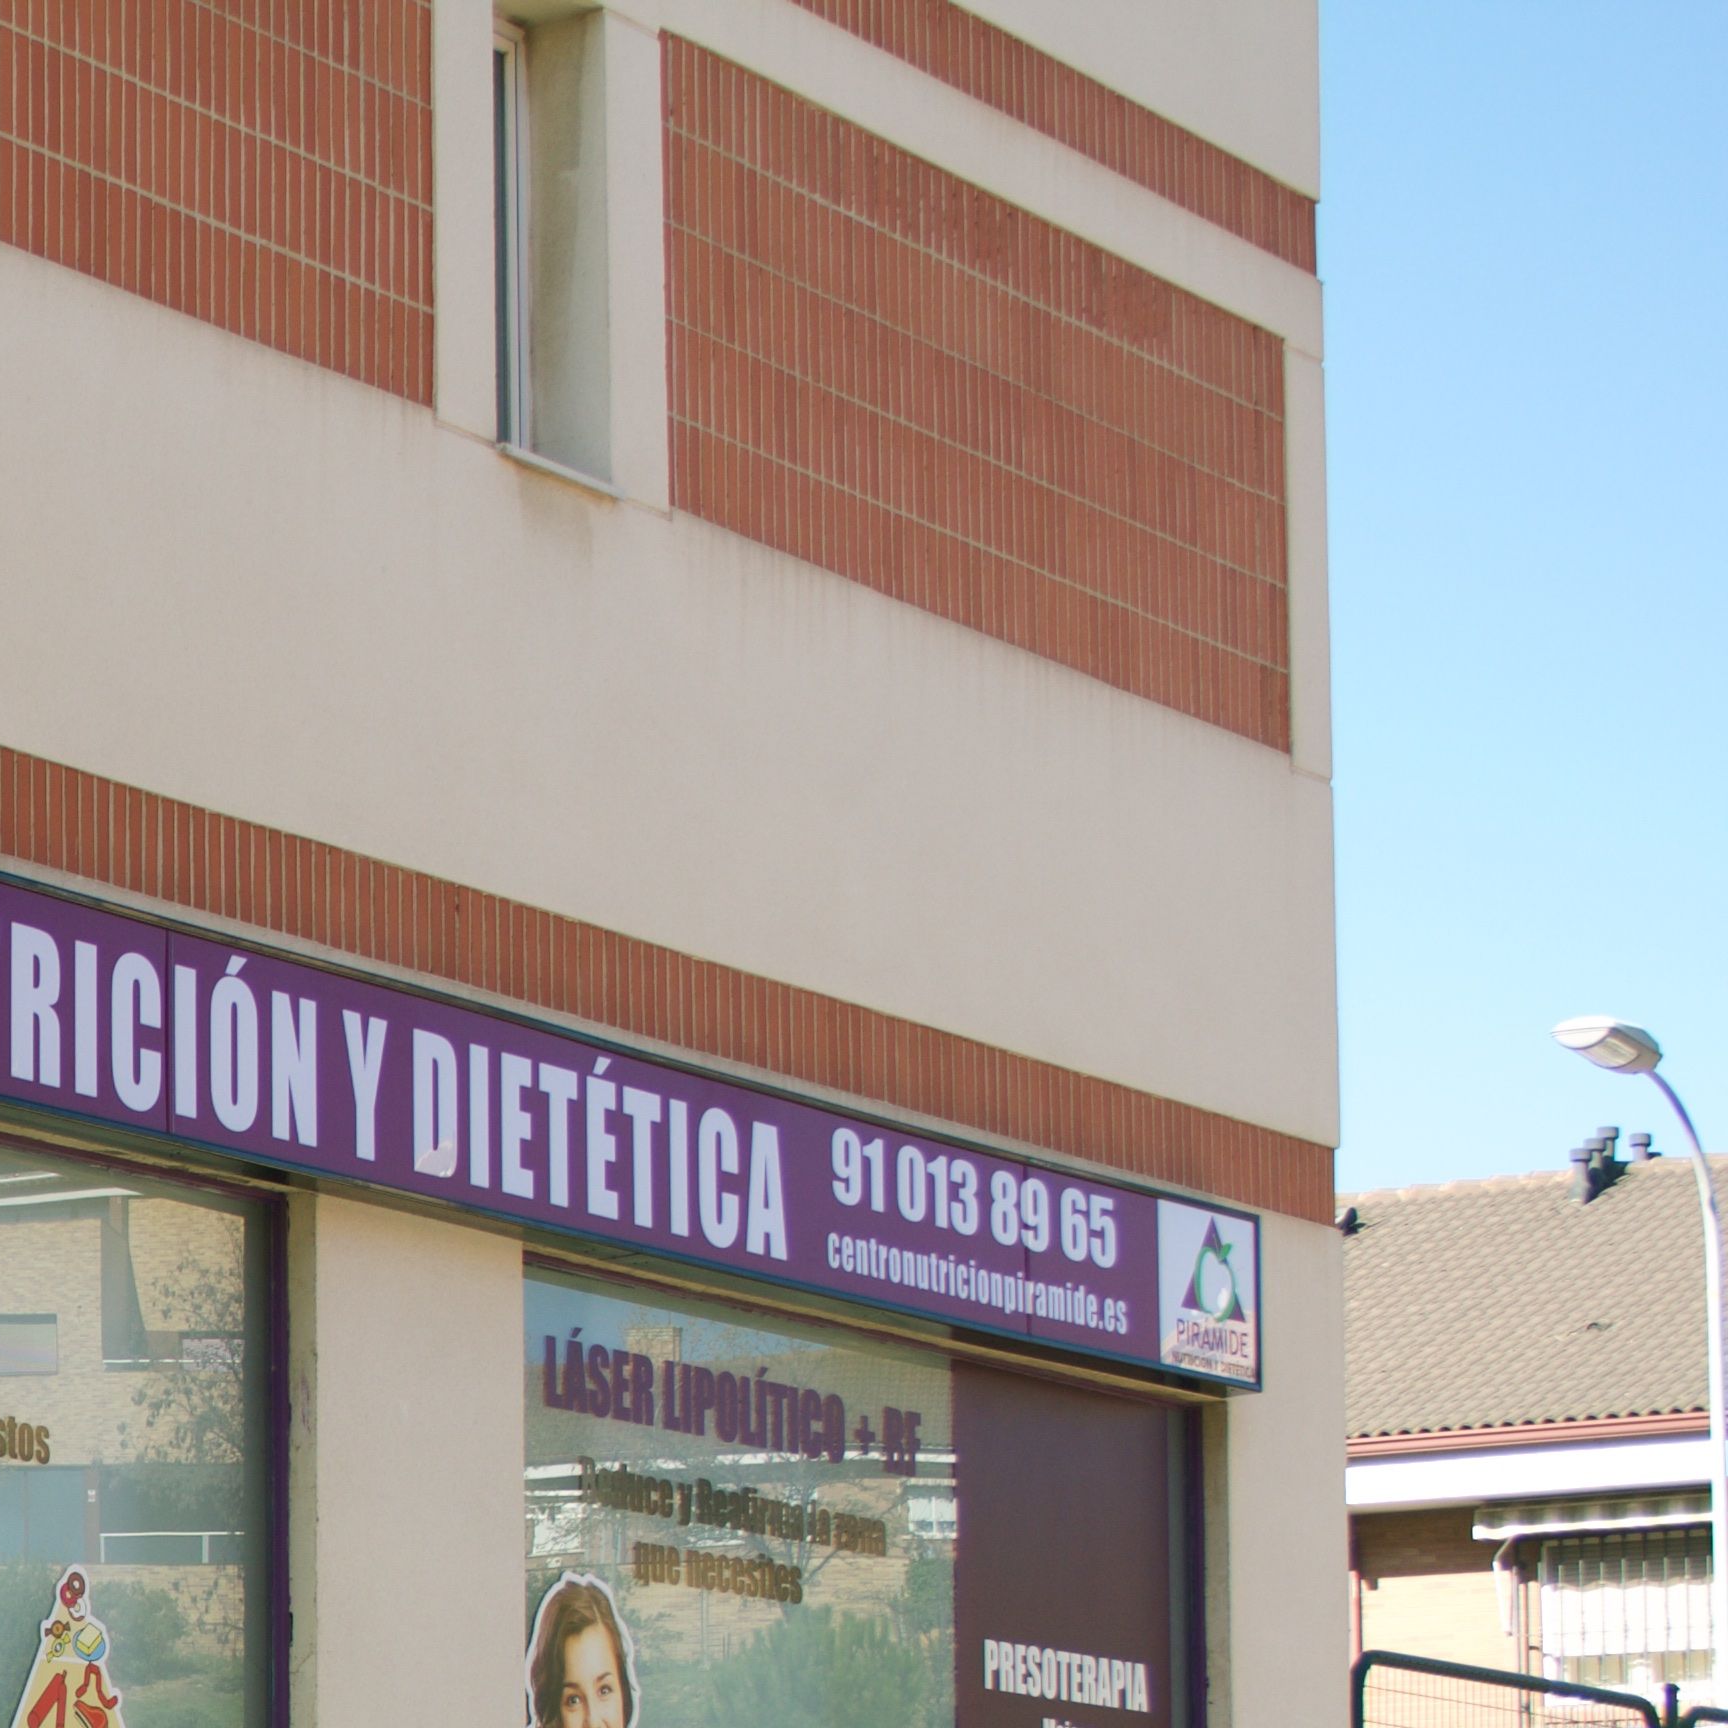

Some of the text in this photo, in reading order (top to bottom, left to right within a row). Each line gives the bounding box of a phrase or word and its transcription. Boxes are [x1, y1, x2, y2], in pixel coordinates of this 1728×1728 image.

[342, 1008, 388, 1162] Y
[412, 1028, 789, 1263] DIETÉTICA
[831, 1127, 1117, 1269] 91 013 89 65
[827, 1231, 1129, 1335] centronutricionpiramide.es
[543, 1327, 922, 1477] LÁSER LIPOLÍTICO + RF
[677, 1482, 693, 1526] y
[632, 1540, 803, 1605] que necesites
[983, 1638, 1149, 1713] PRESOTERAPIA
